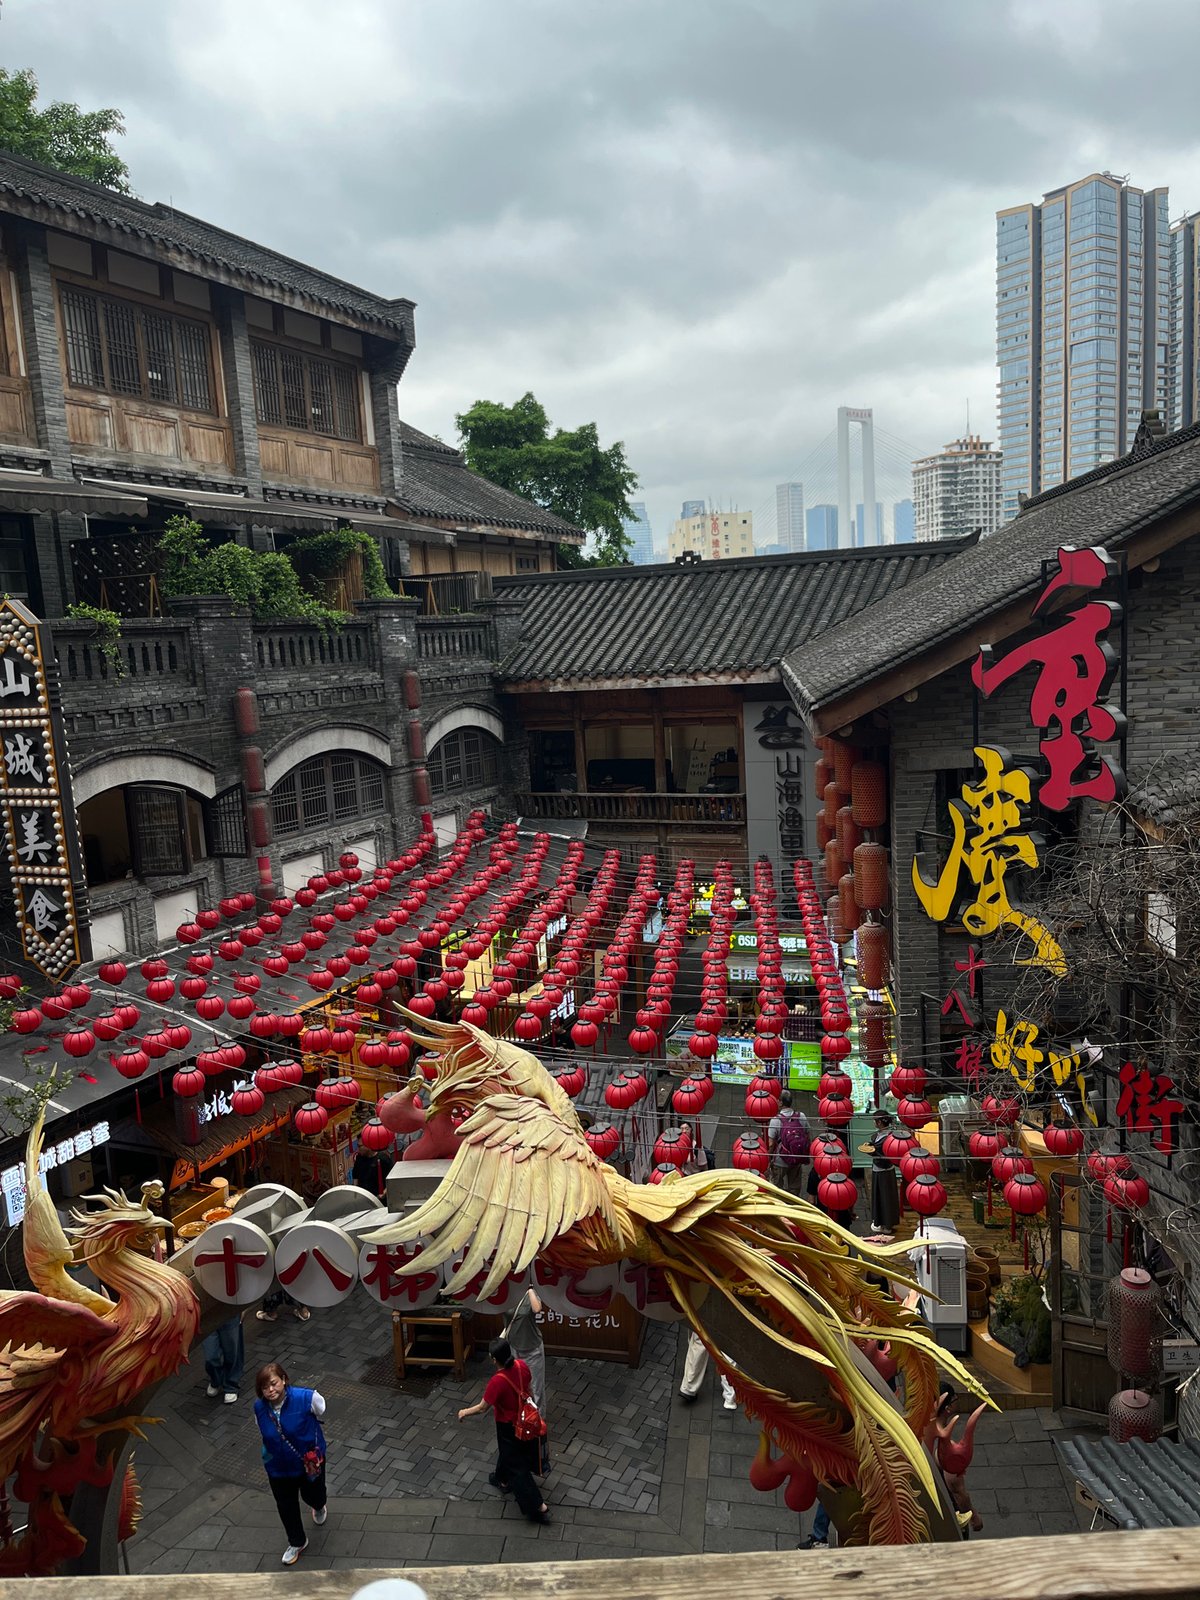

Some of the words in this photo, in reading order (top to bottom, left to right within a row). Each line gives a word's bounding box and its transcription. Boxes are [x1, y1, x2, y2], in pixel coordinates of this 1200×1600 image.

[0, 657, 58, 932] 山城美食
[1166, 1351, 1200, 1361] 卫生
